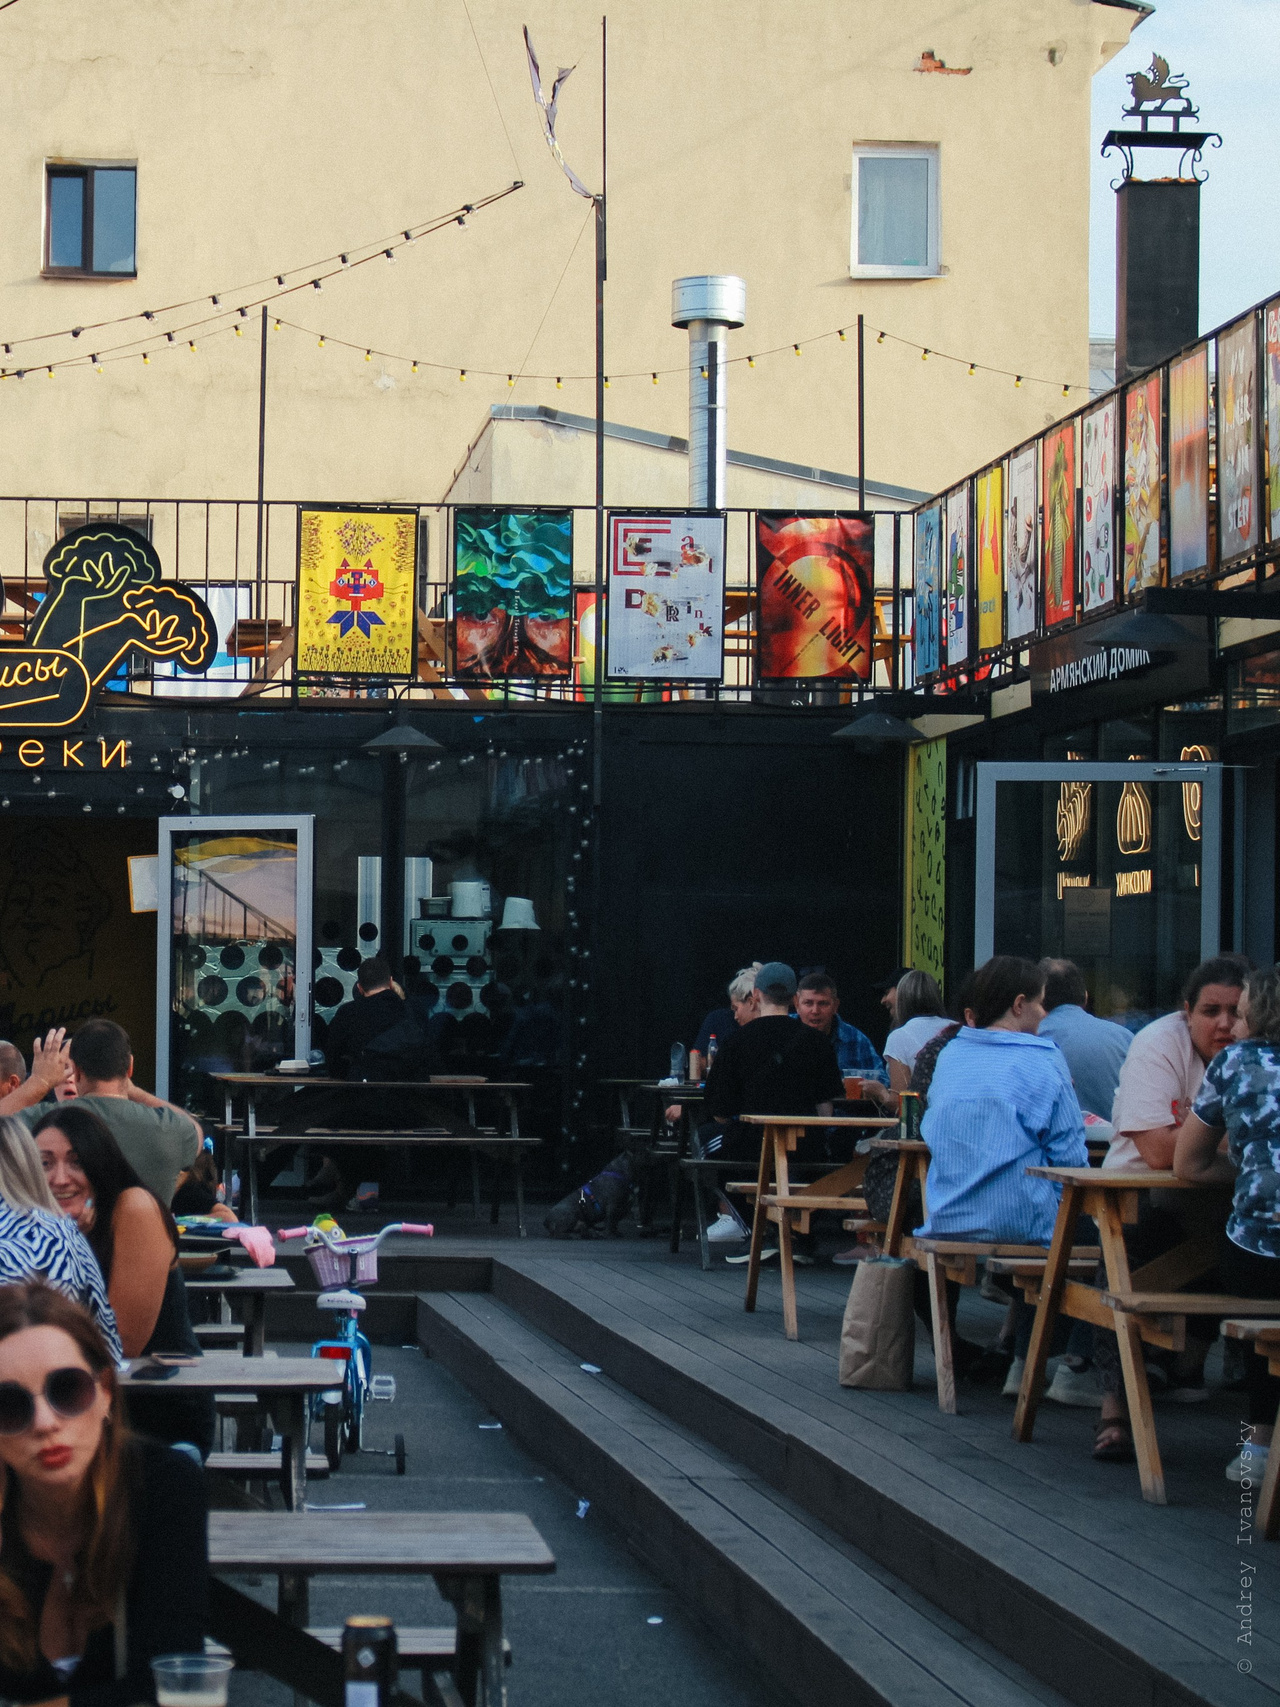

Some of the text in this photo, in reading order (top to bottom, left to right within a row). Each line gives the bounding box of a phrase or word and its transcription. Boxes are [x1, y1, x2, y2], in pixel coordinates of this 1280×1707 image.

[773, 569, 821, 620] INNER
[818, 616, 866, 664] LIGHT
[1049, 646, 1108, 694] АРМЯНСКИЙ
